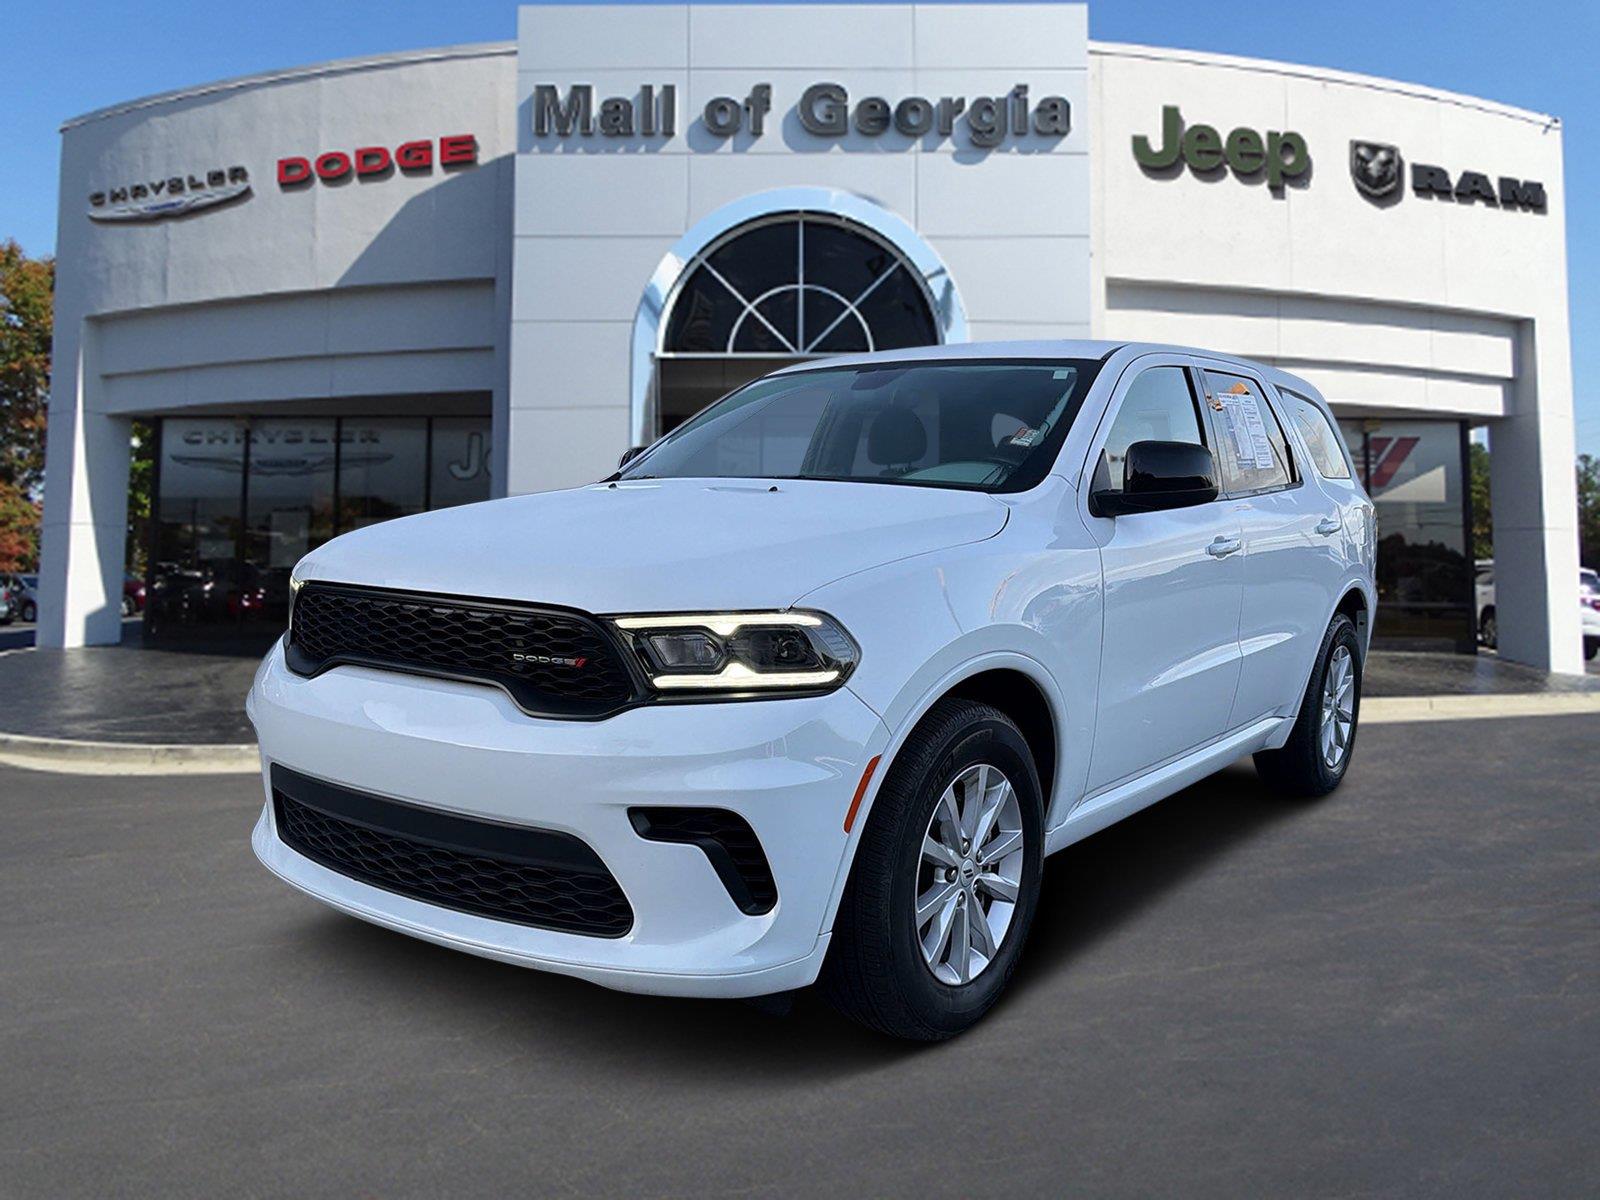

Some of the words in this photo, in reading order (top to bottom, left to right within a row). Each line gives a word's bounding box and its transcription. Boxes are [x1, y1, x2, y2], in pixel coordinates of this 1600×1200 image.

[534, 84, 676, 137] Mall
[704, 83, 772, 136] of
[800, 83, 1071, 148] Georgia
[277, 134, 478, 185] DODGE
[1131, 105, 1308, 187] Jeep
[89, 166, 249, 207] CHRYSLER
[1411, 163, 1547, 213] RAM
[513, 653, 576, 666] DODGE
